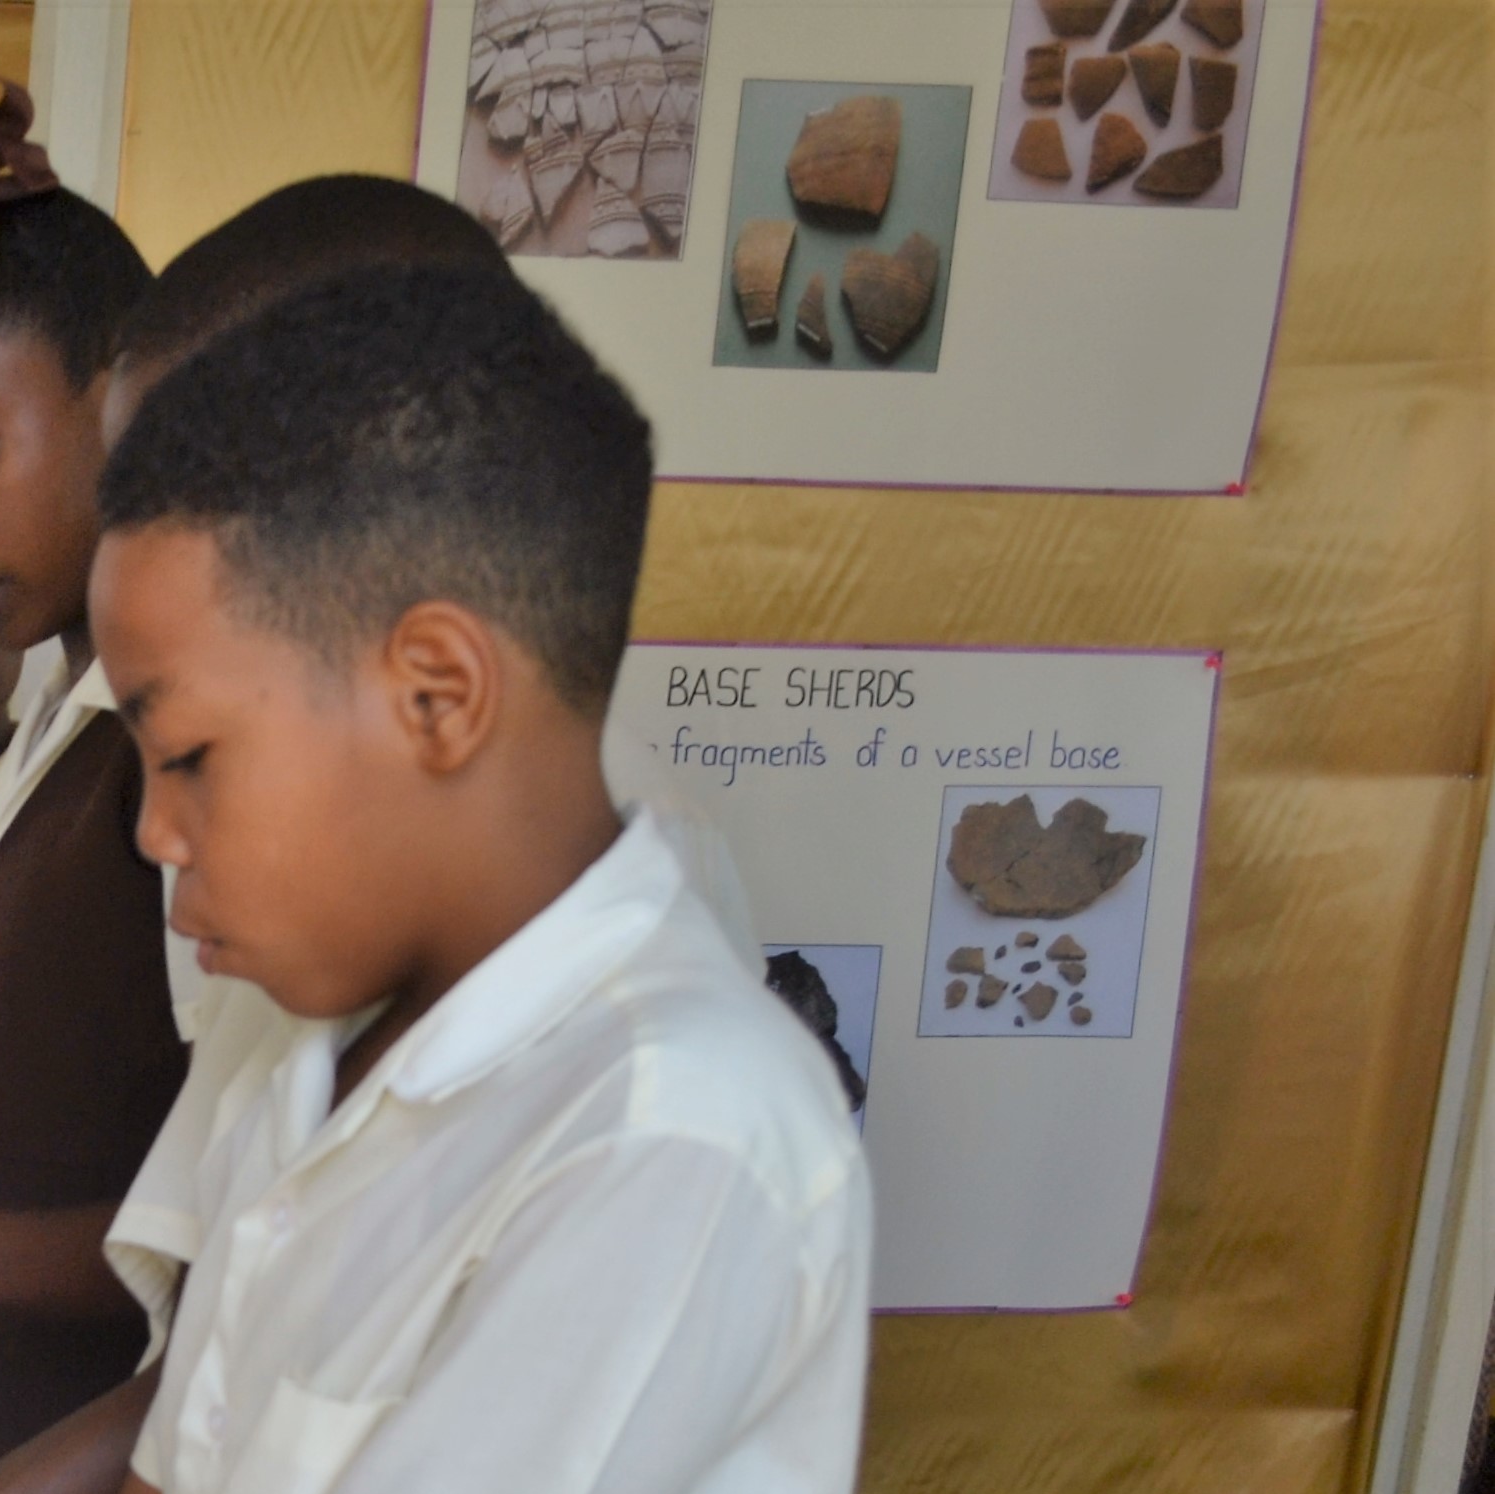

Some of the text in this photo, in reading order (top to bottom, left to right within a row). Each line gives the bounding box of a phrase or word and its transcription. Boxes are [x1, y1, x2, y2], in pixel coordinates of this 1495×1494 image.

[667, 666, 916, 709] BASE SHERDS
[671, 726, 827, 787] fragments
[856, 727, 887, 767] of
[901, 744, 918, 768] a
[935, 730, 1033, 769] vessel
